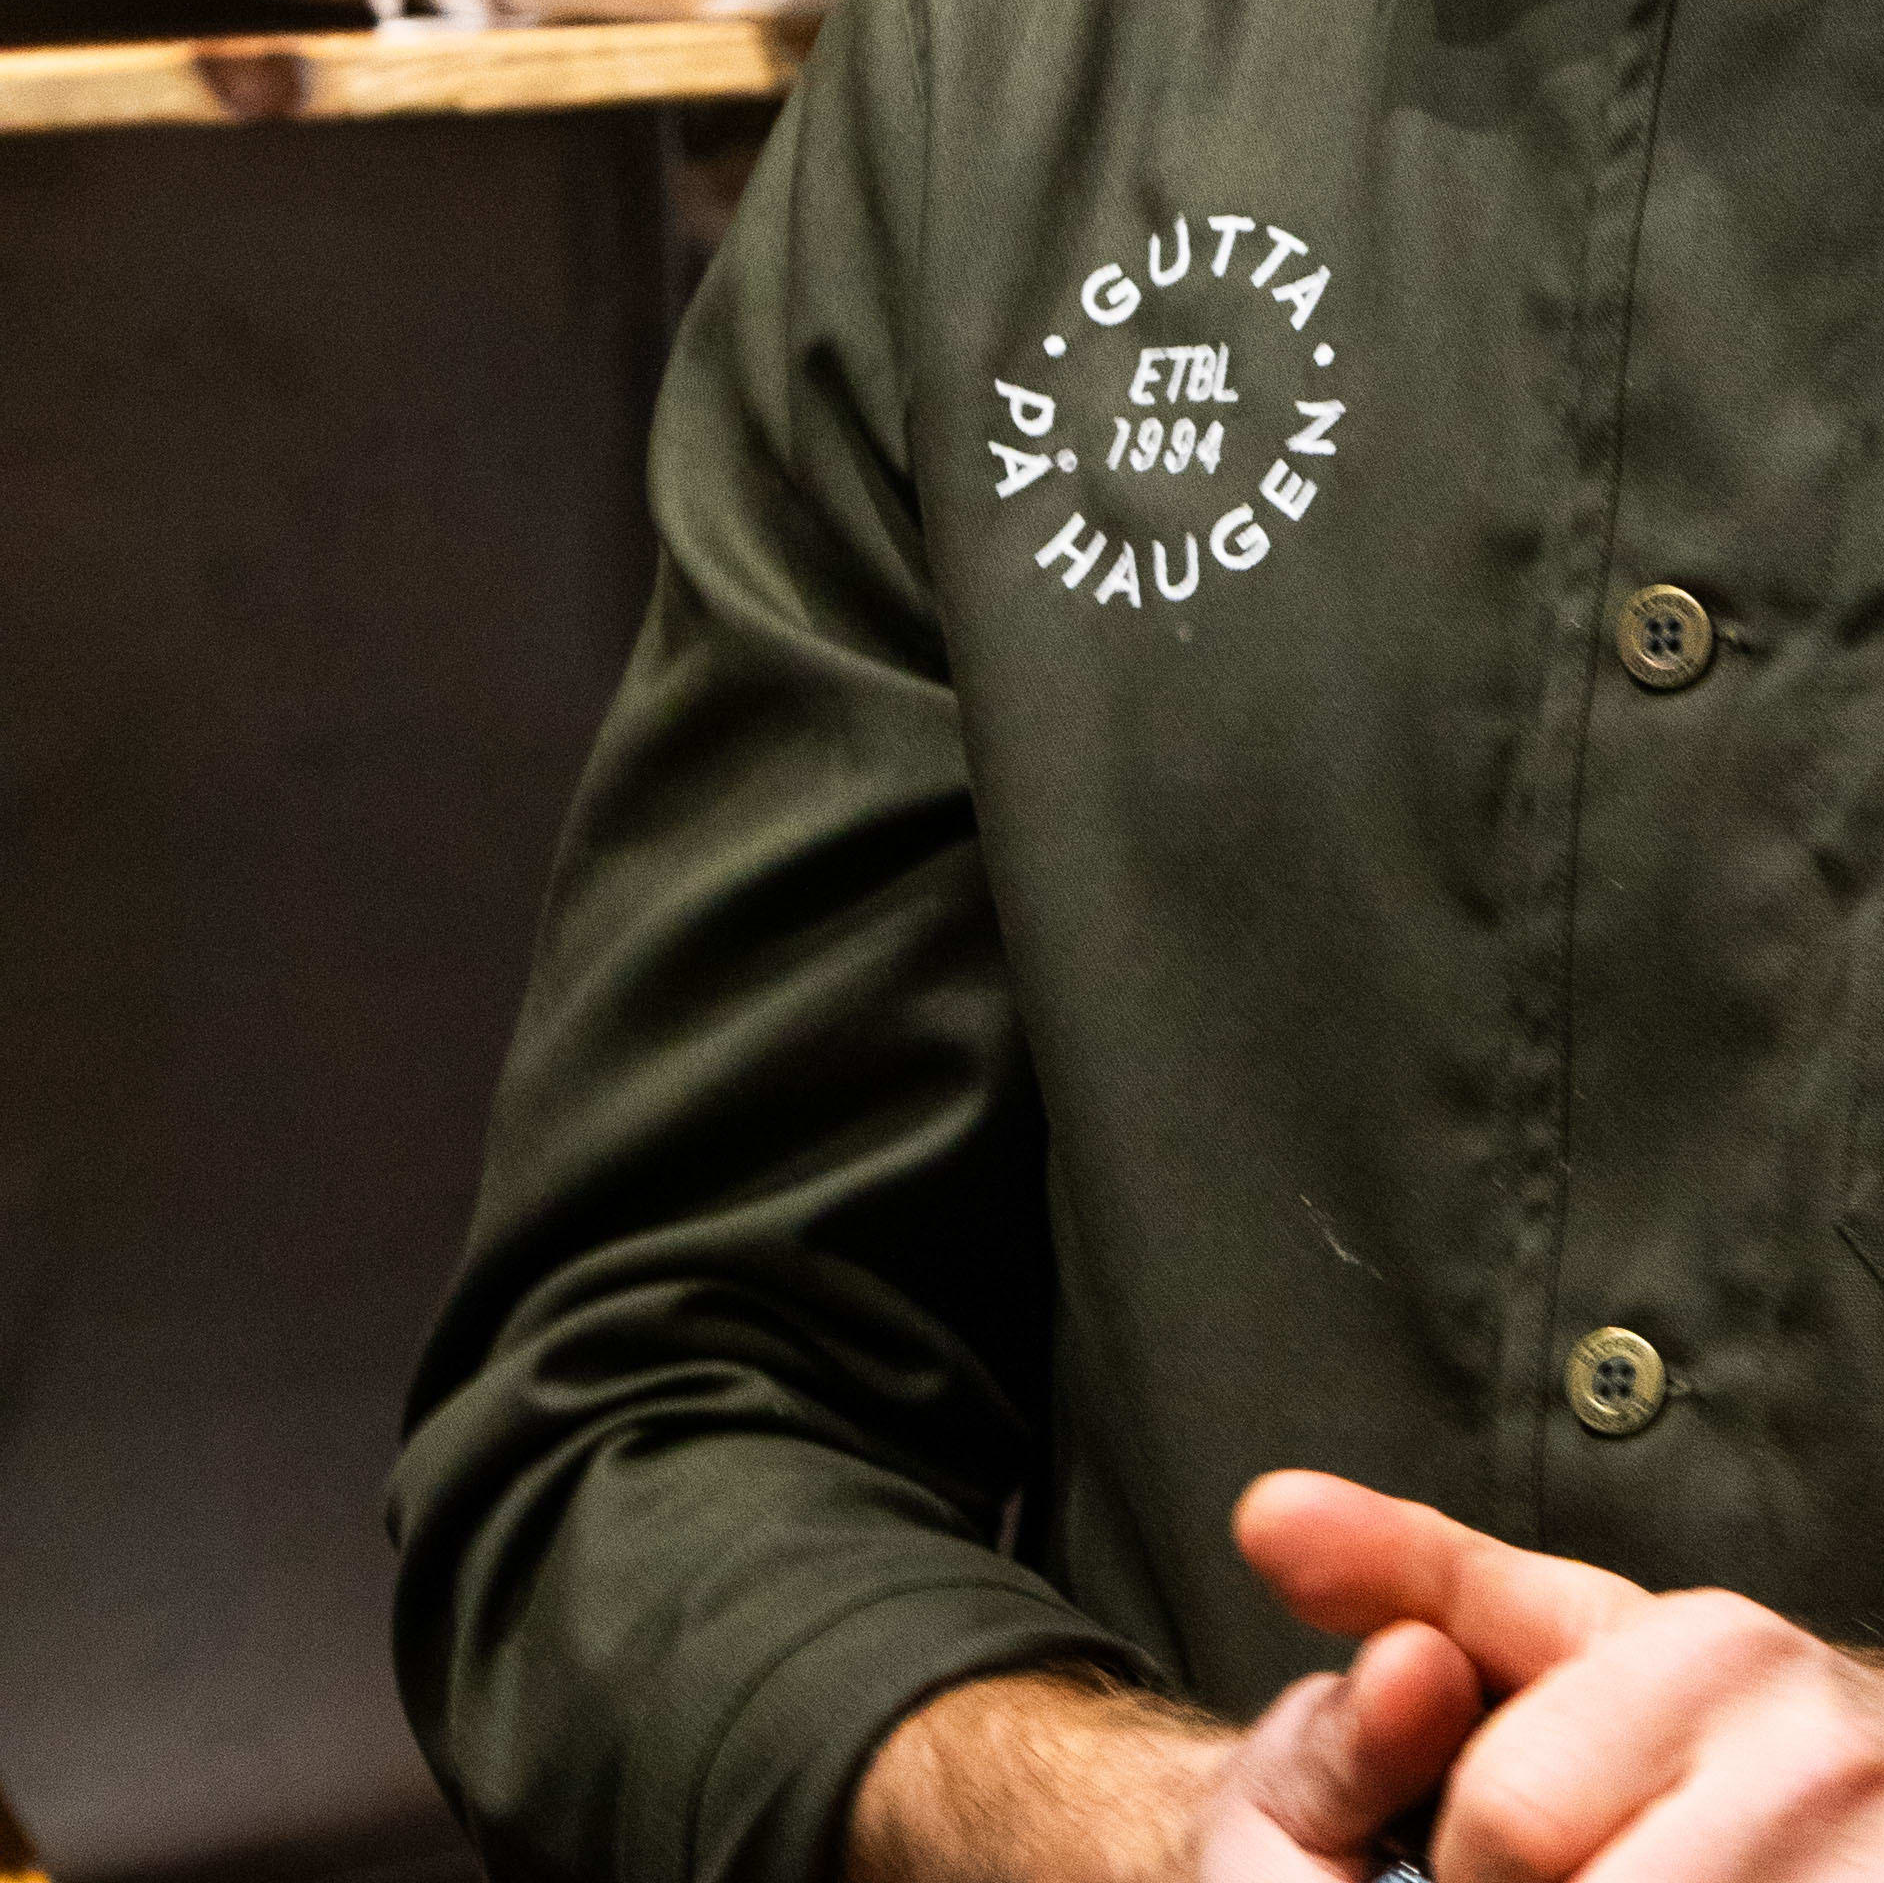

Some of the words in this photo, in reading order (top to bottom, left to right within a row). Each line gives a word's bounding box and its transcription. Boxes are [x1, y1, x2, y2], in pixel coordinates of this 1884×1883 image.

[1080, 211, 1331, 331] GUTTA
[1128, 341, 1239, 406] ETBL
[987, 379, 1077, 499] PÅ
[1107, 416, 1224, 475] 1994
[1034, 399, 1347, 609] HAUGEN
